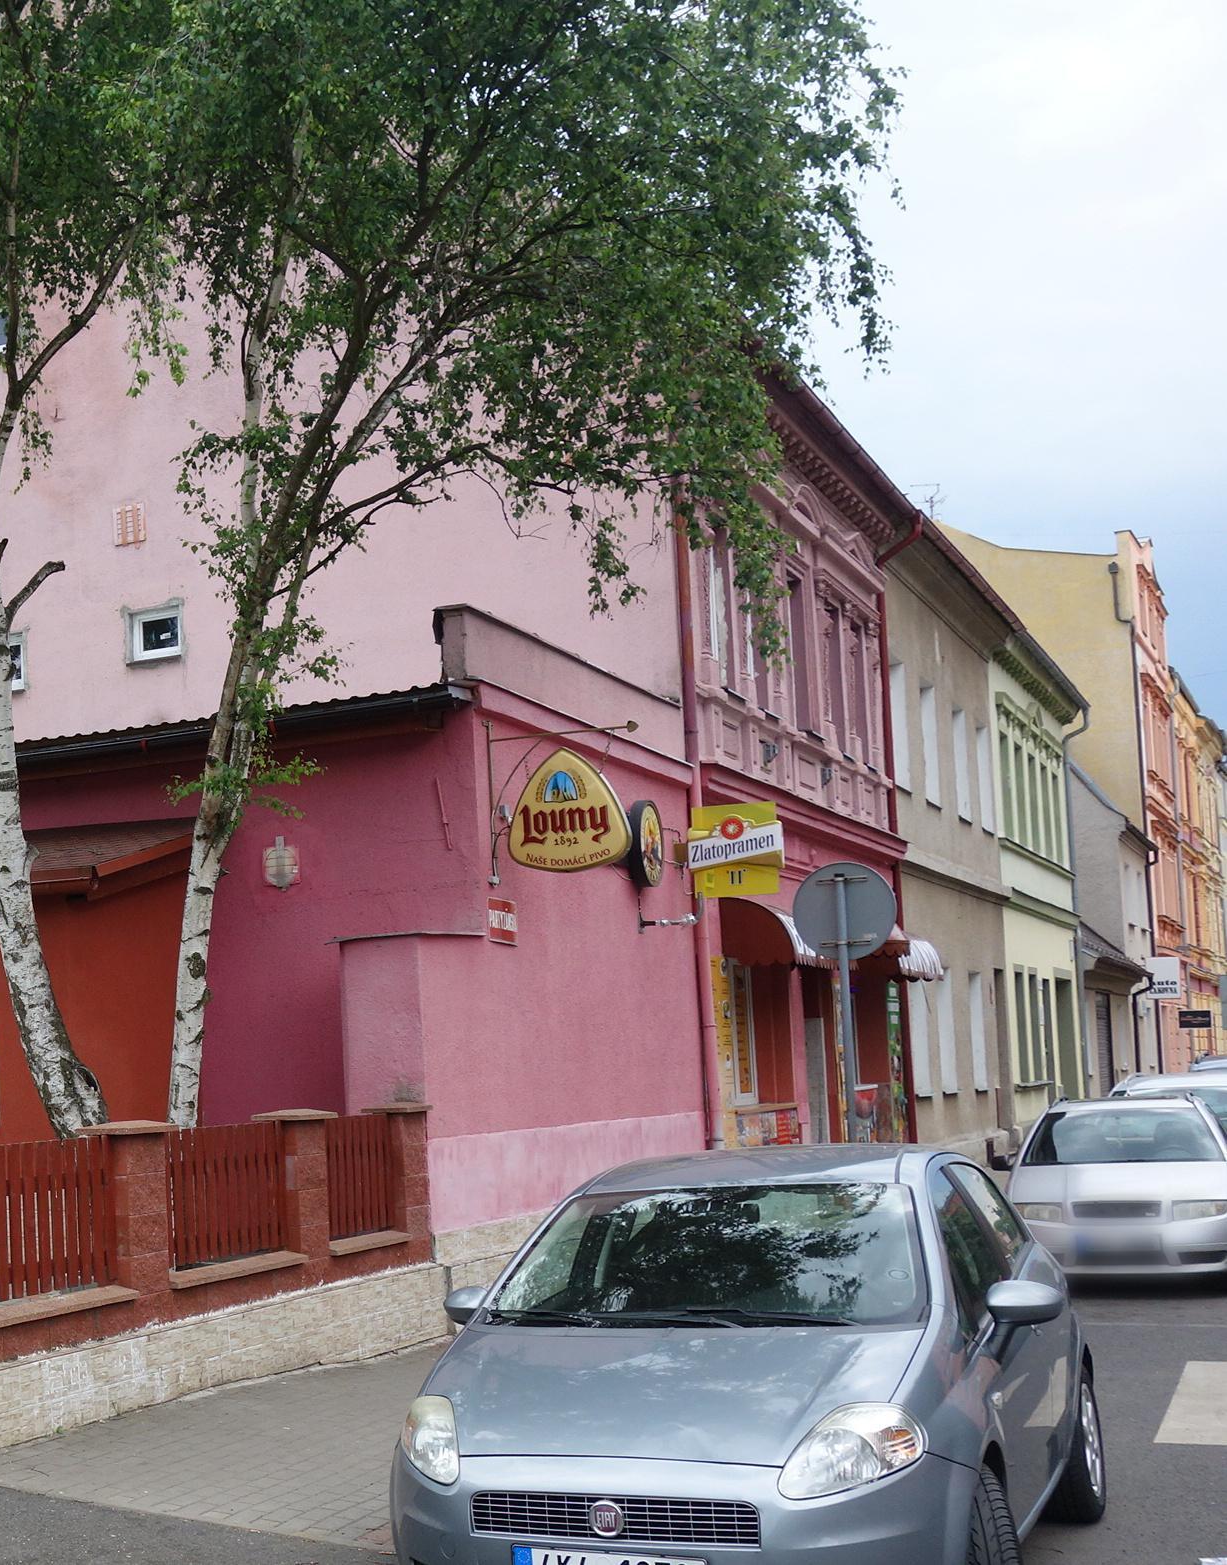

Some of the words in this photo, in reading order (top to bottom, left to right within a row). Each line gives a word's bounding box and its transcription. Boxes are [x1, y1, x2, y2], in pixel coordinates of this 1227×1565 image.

[518, 803, 610, 847] Louny
[553, 836, 579, 846] 1892
[690, 834, 775, 863] Zlatopramen
[526, 853, 548, 865] NAŠE
[550, 853, 587, 867] DOMÁCÍ
[589, 848, 611, 862] PIVO
[596, 1510, 617, 1530] FIAT
